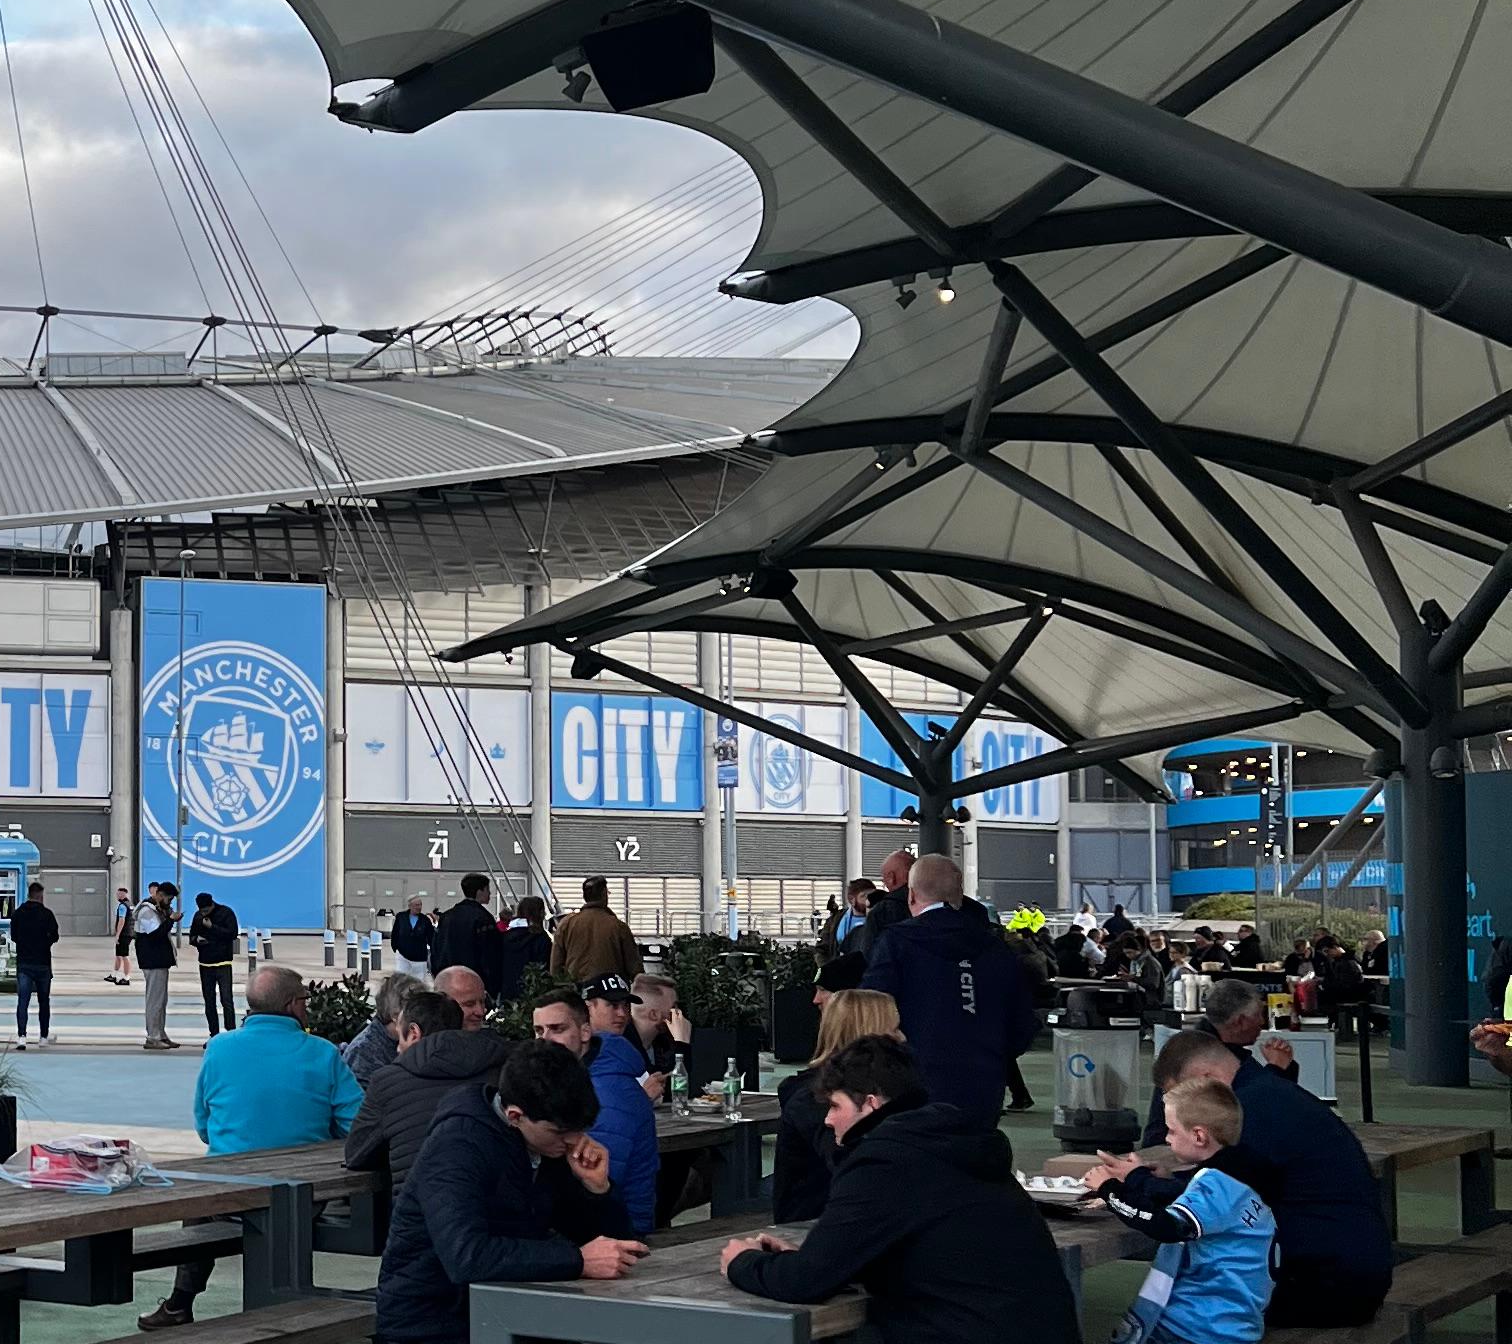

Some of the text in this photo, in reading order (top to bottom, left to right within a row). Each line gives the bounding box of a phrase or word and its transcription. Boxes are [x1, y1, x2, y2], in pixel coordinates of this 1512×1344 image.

[157, 659, 318, 744] MANCHESTER
[146, 737, 161, 750] 18
[563, 706, 685, 803] CITY
[302, 767, 321, 782] 94
[192, 831, 252, 859] CITY
[428, 837, 449, 859] Z1
[615, 840, 641, 861] Y2
[960, 972, 976, 1014] CITY
